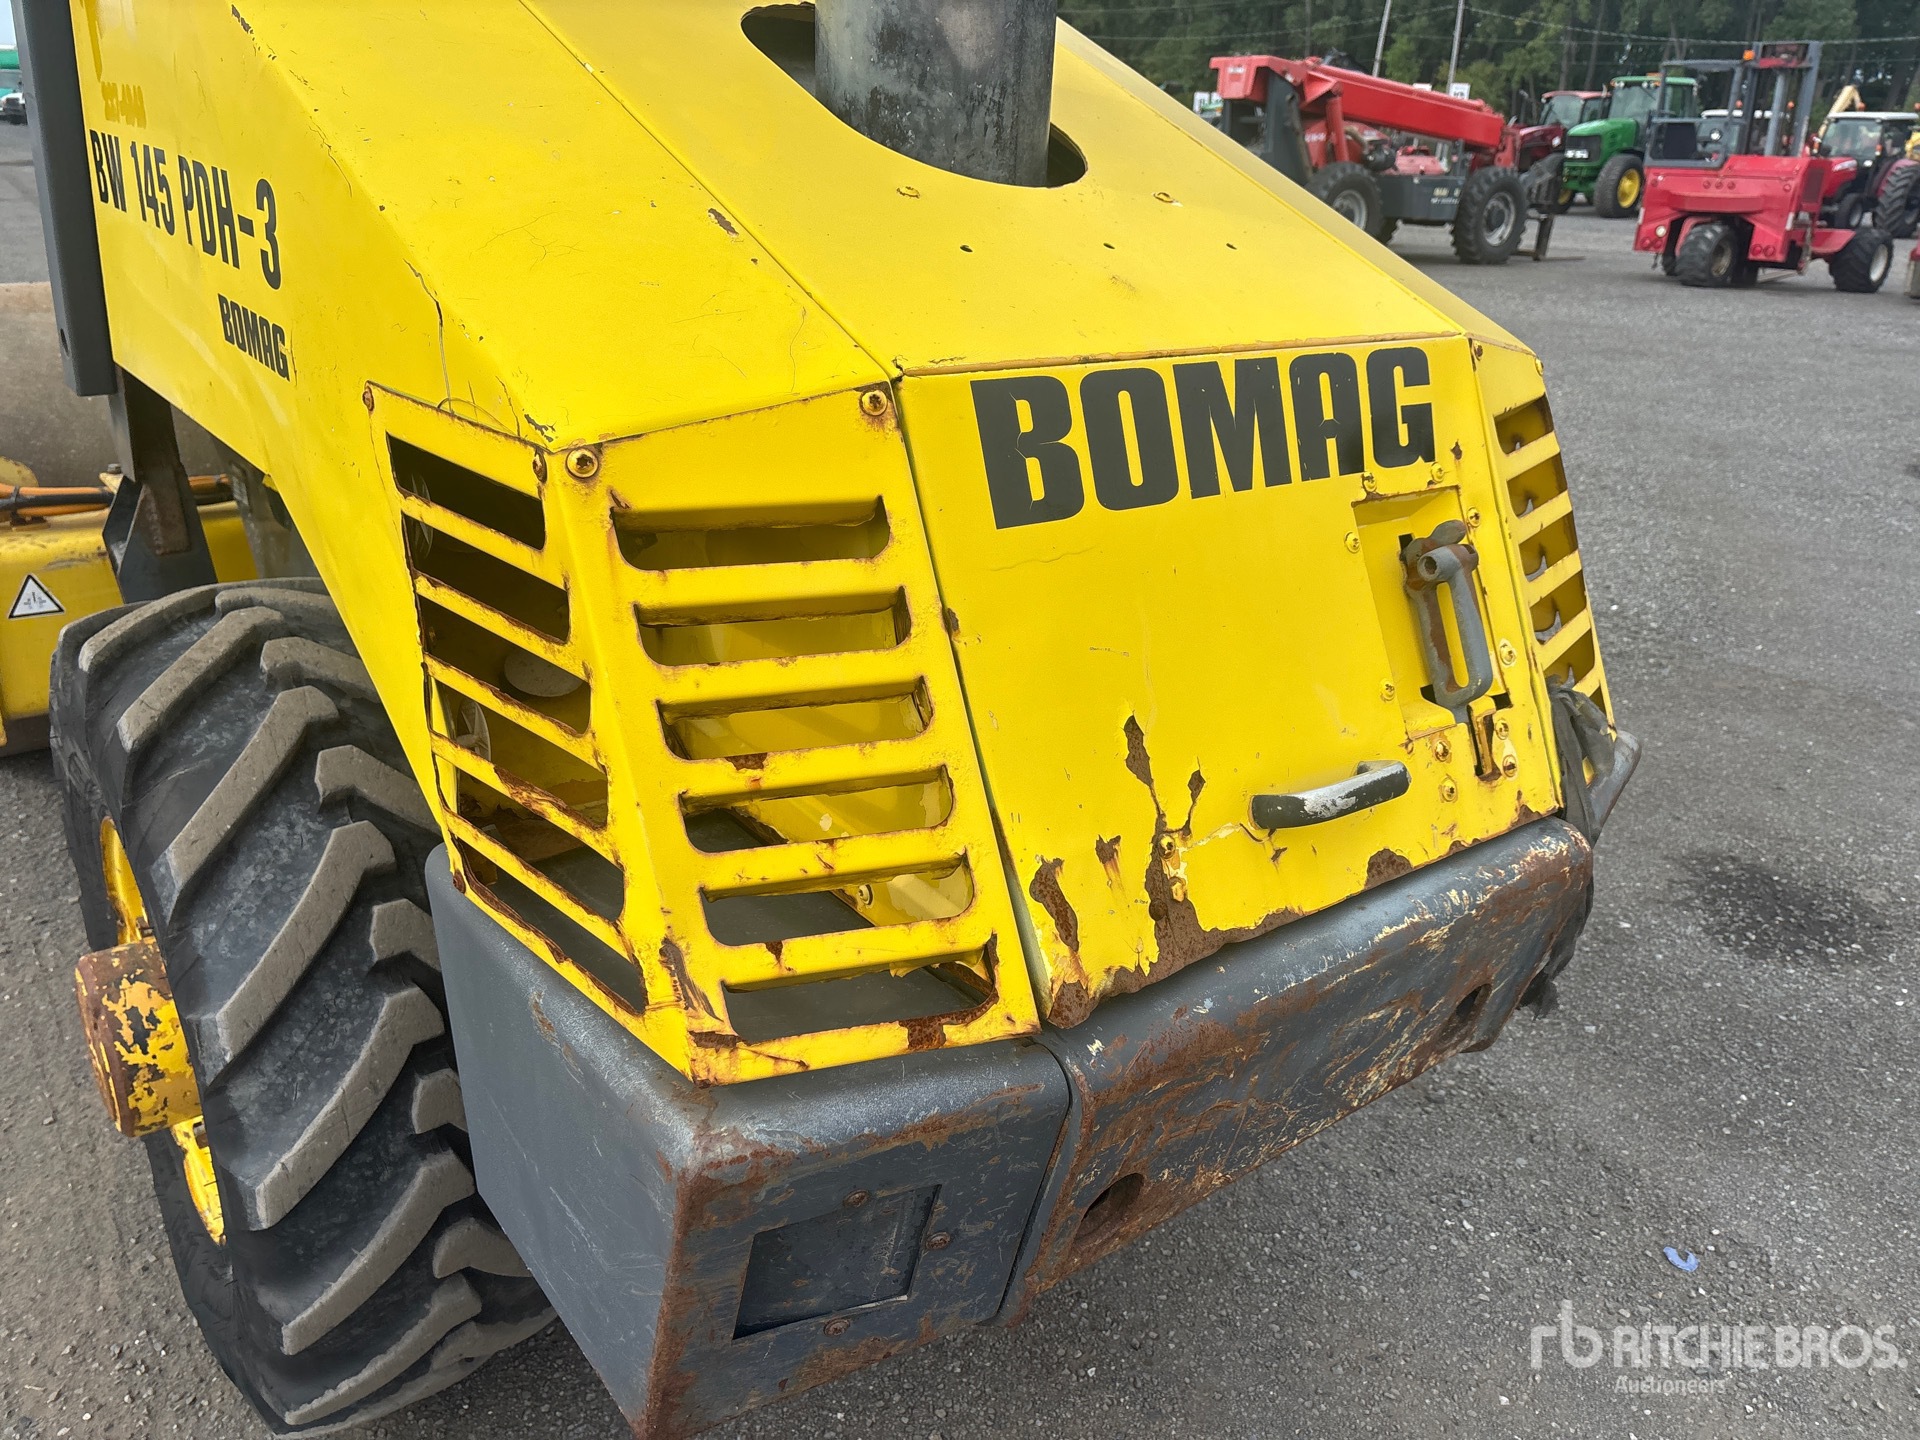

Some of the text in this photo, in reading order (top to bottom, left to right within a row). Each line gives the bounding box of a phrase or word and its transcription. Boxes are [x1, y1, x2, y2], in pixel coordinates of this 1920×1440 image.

[89, 129, 281, 290] BW 145 PDH-3
[217, 293, 290, 382] BOMAG
[970, 347, 1436, 529] BOMAG
